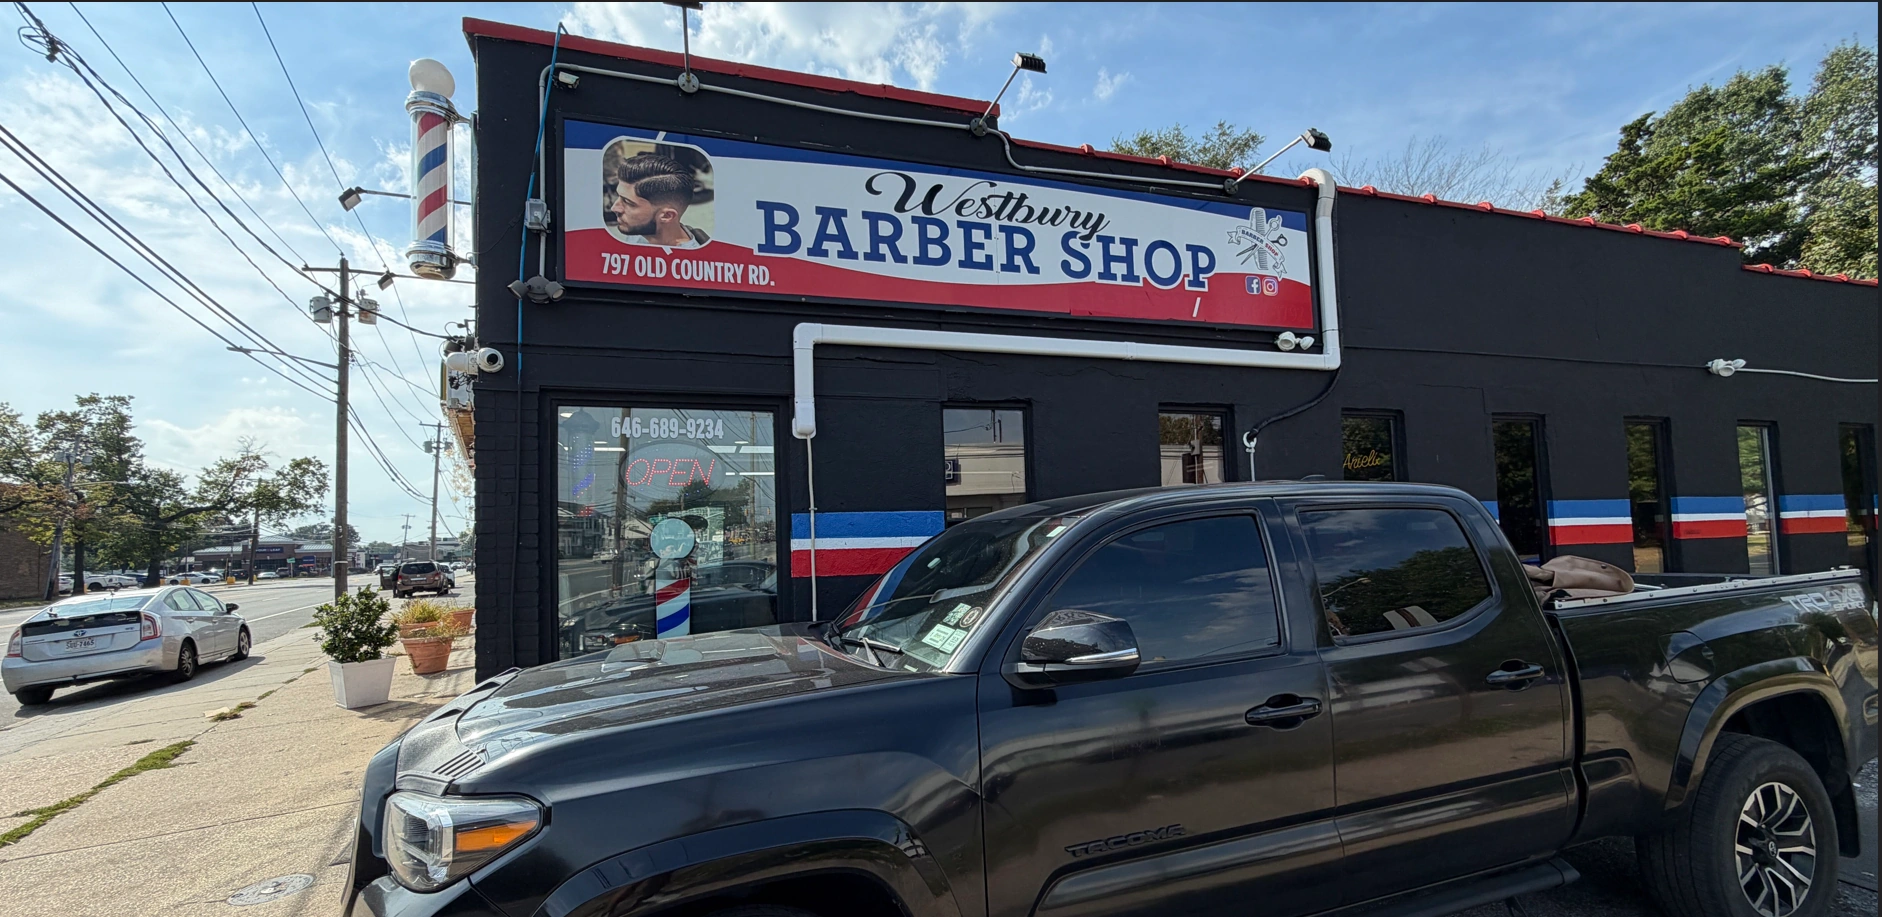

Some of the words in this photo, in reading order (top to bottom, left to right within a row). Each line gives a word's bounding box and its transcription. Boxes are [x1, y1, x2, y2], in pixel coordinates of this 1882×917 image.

[865, 171, 1110, 241] Westbury
[755, 200, 1041, 275] BARBER
[1060, 231, 1217, 289] SHOP
[1241, 229, 1264, 244] BARBER
[1265, 243, 1279, 257] SHOP
[601, 252, 629, 275] 797
[634, 255, 667, 279] OLD
[671, 258, 744, 284] COUNTRY
[748, 264, 775, 286] RD.
[611, 416, 724, 439] 646-689-9234
[625, 457, 716, 486] OPEN
[1780, 592, 1830, 613] TRD
[1064, 823, 1187, 857] TACOMA
